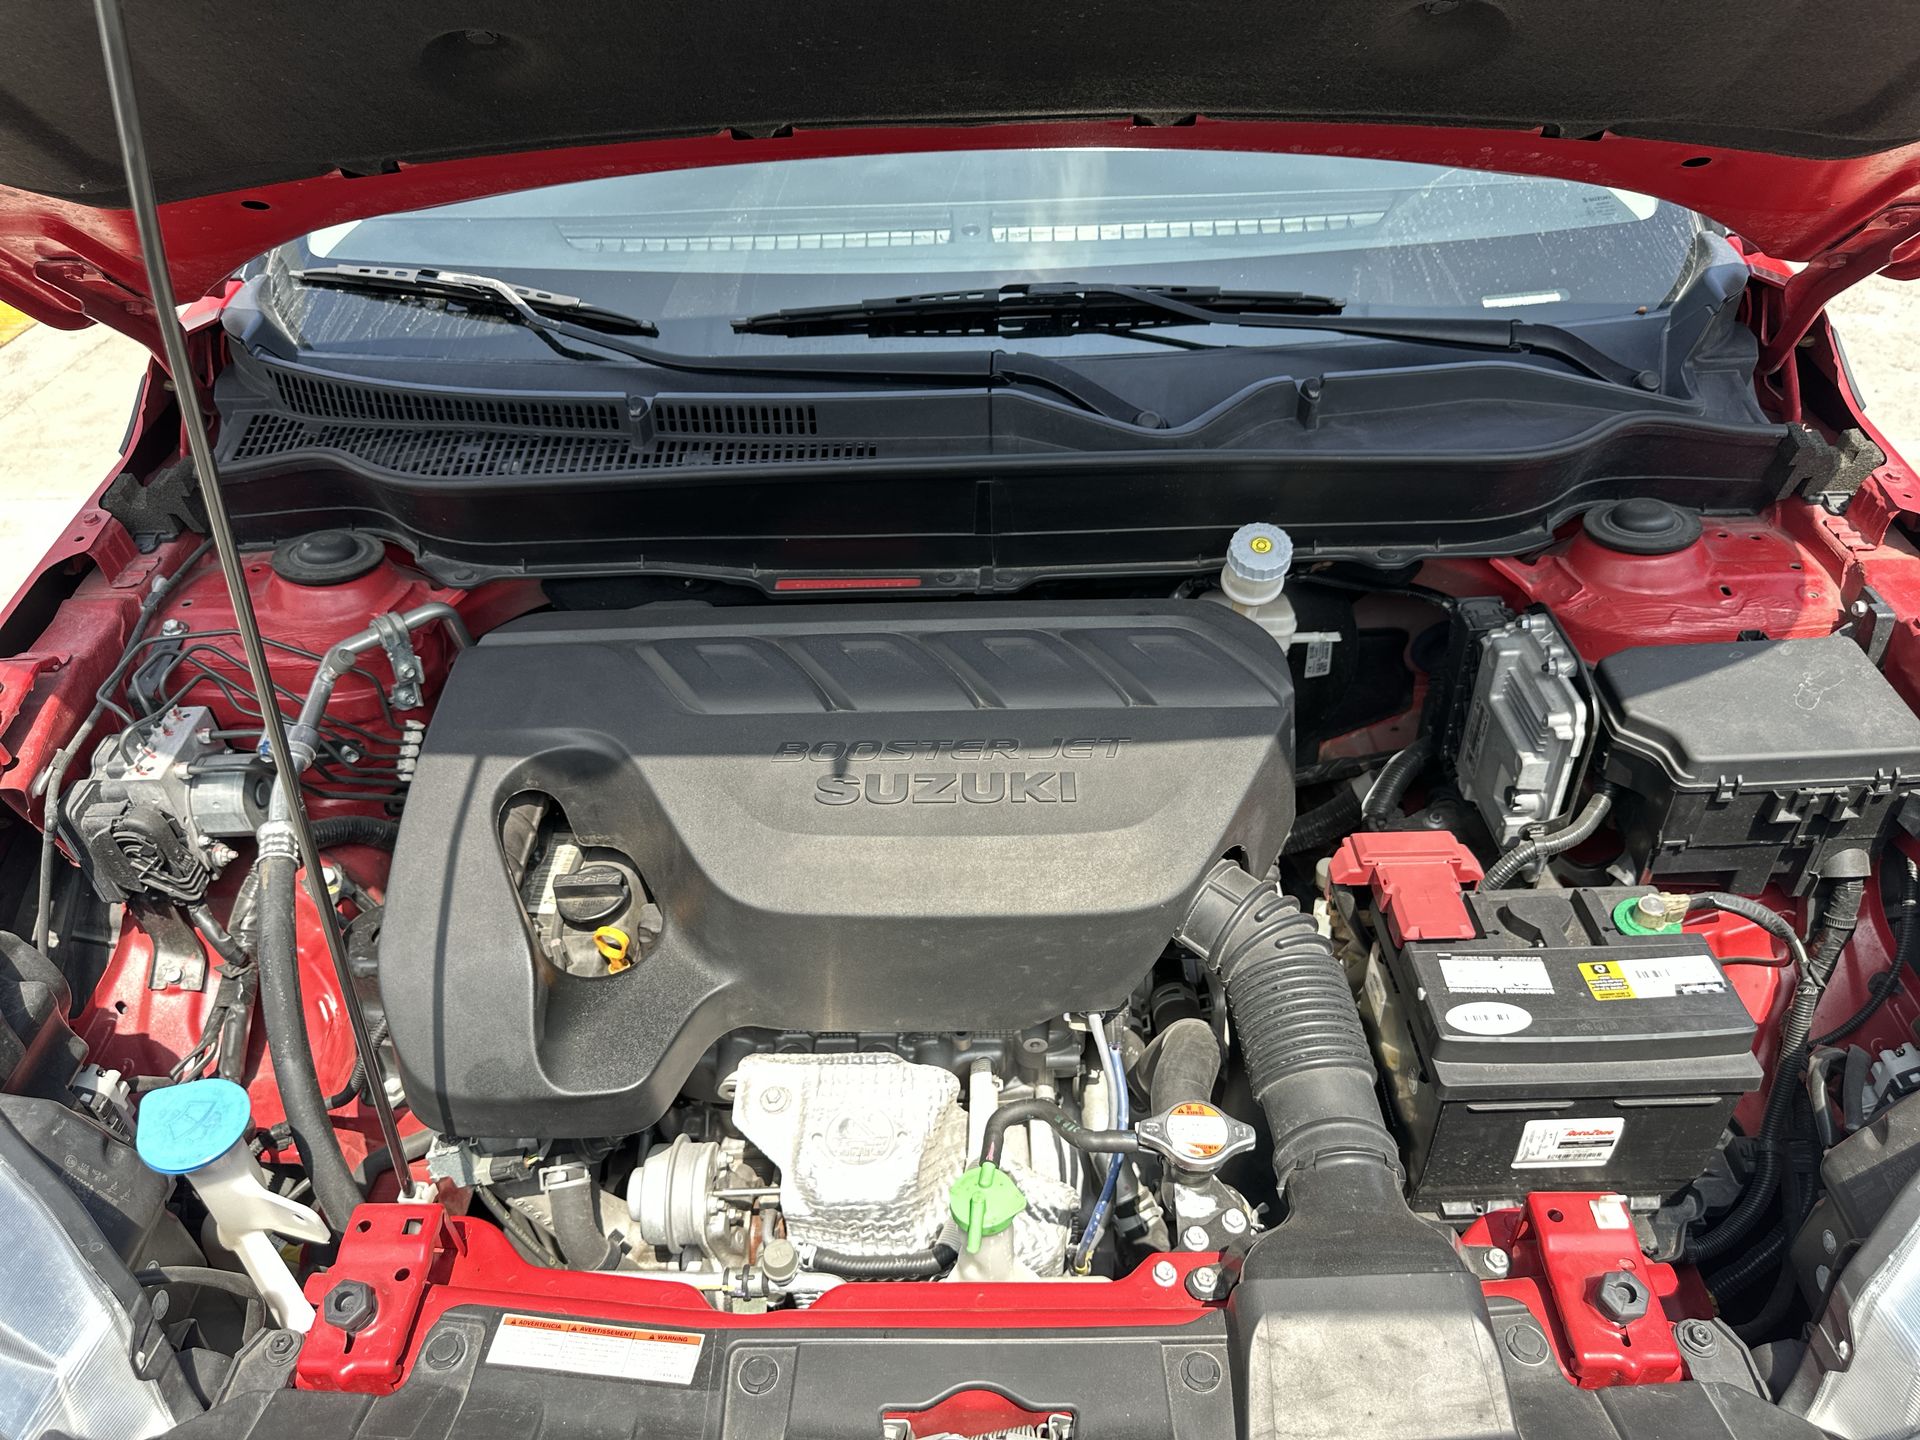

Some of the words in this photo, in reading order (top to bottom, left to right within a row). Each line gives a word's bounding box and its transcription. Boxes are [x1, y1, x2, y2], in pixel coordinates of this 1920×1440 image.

[771, 738, 1020, 763] BOOSTER
[1028, 737, 1131, 760] JET
[814, 771, 1077, 806] SUZUKI
[1565, 1129, 1615, 1137] AutoZone
[518, 1319, 562, 1330] ADVERTENCIA
[579, 1326, 633, 1338] AVERTISSEMENT
[657, 1334, 689, 1343] WARNING
